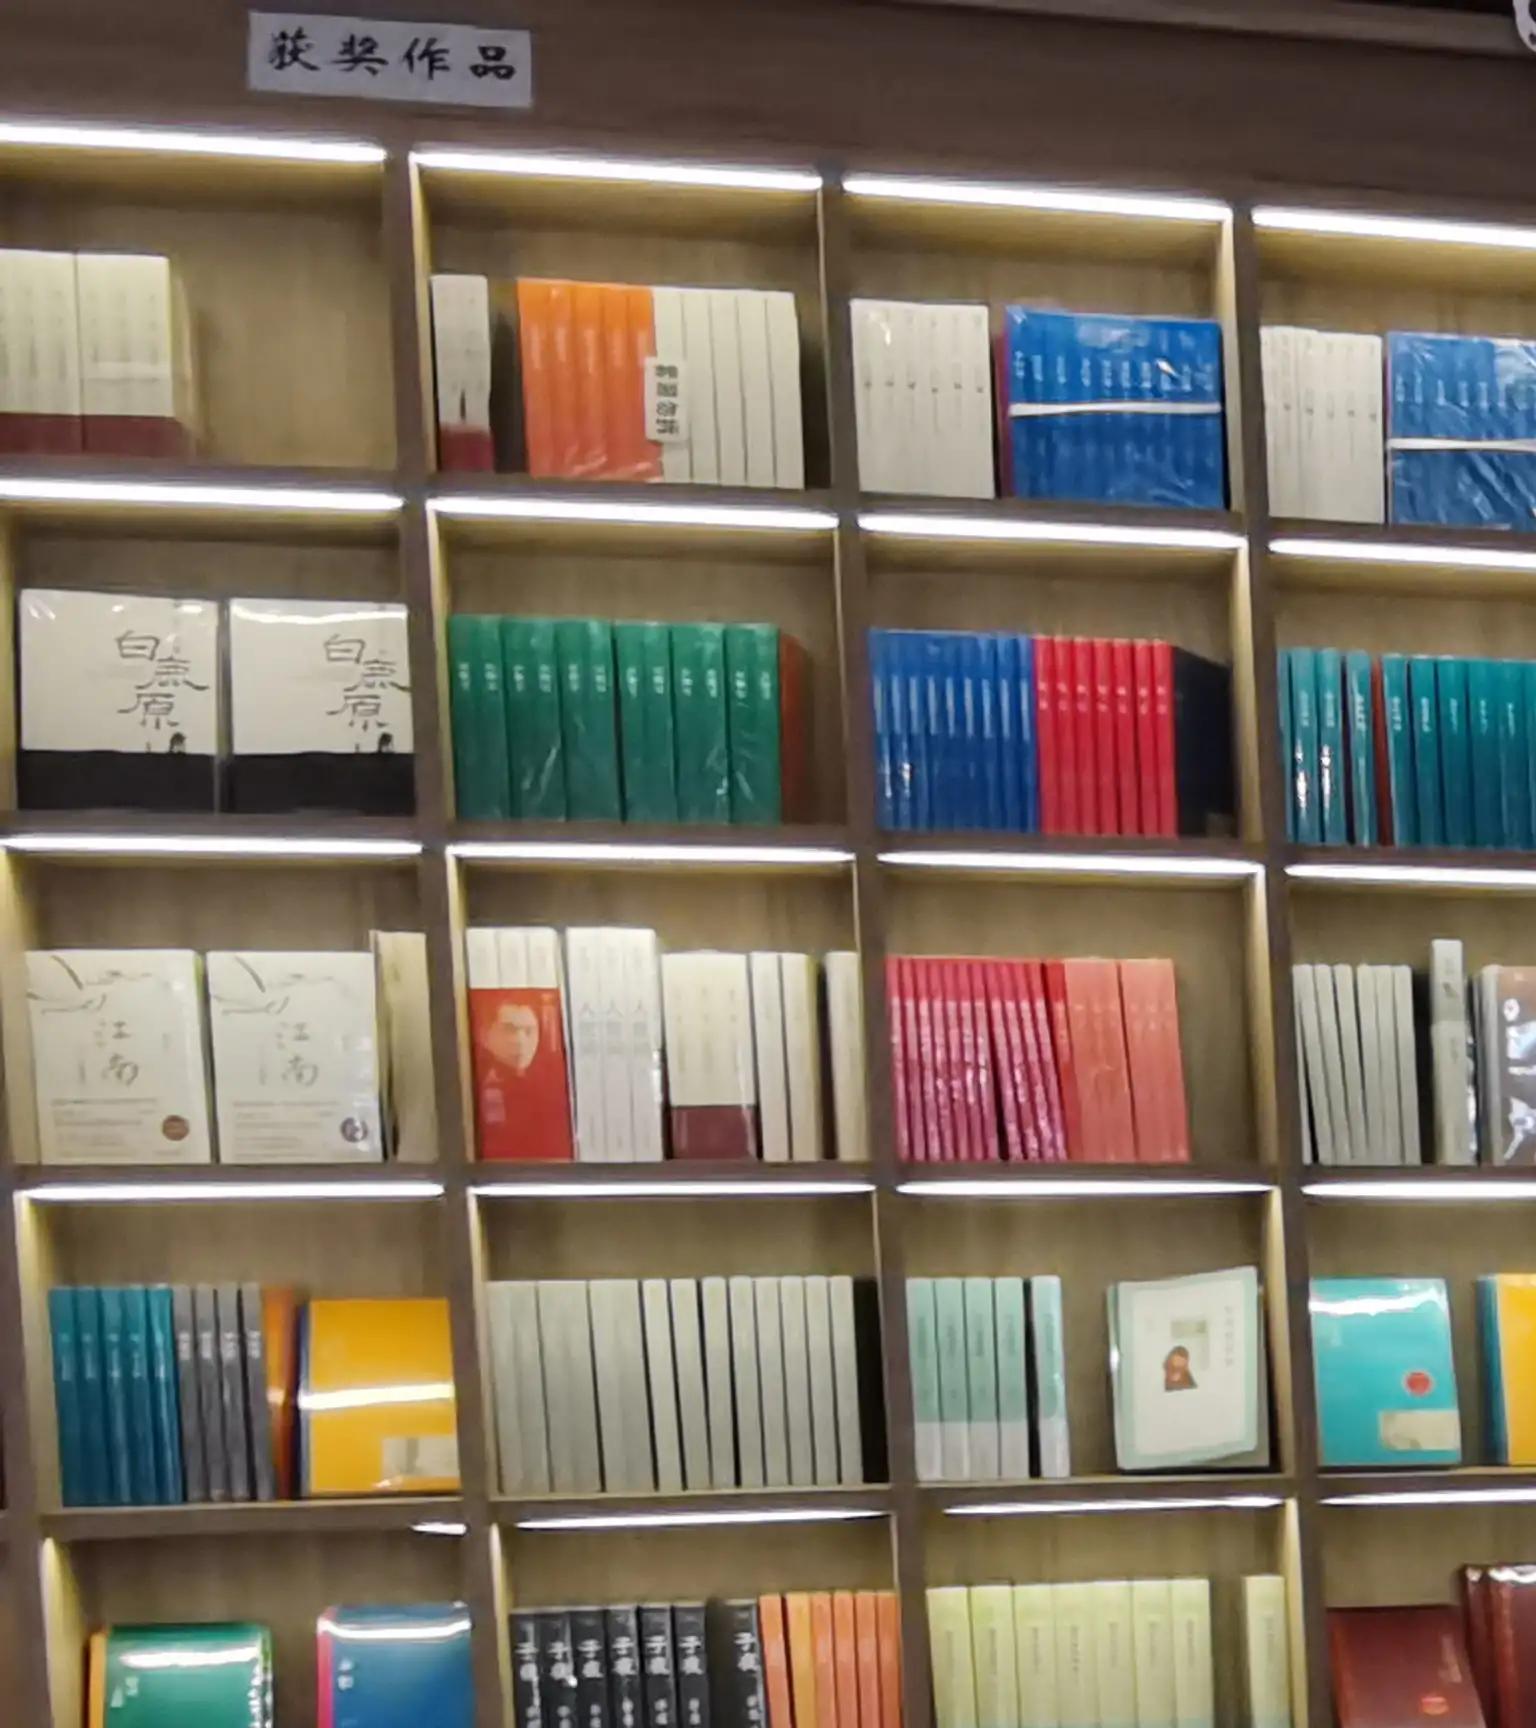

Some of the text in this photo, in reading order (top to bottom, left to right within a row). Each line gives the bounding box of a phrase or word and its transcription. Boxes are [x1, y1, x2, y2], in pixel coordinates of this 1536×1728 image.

[267, 32, 518, 80] 获奖作品
[115, 629, 209, 730] 白鹿原
[322, 632, 412, 732] 白鹿原
